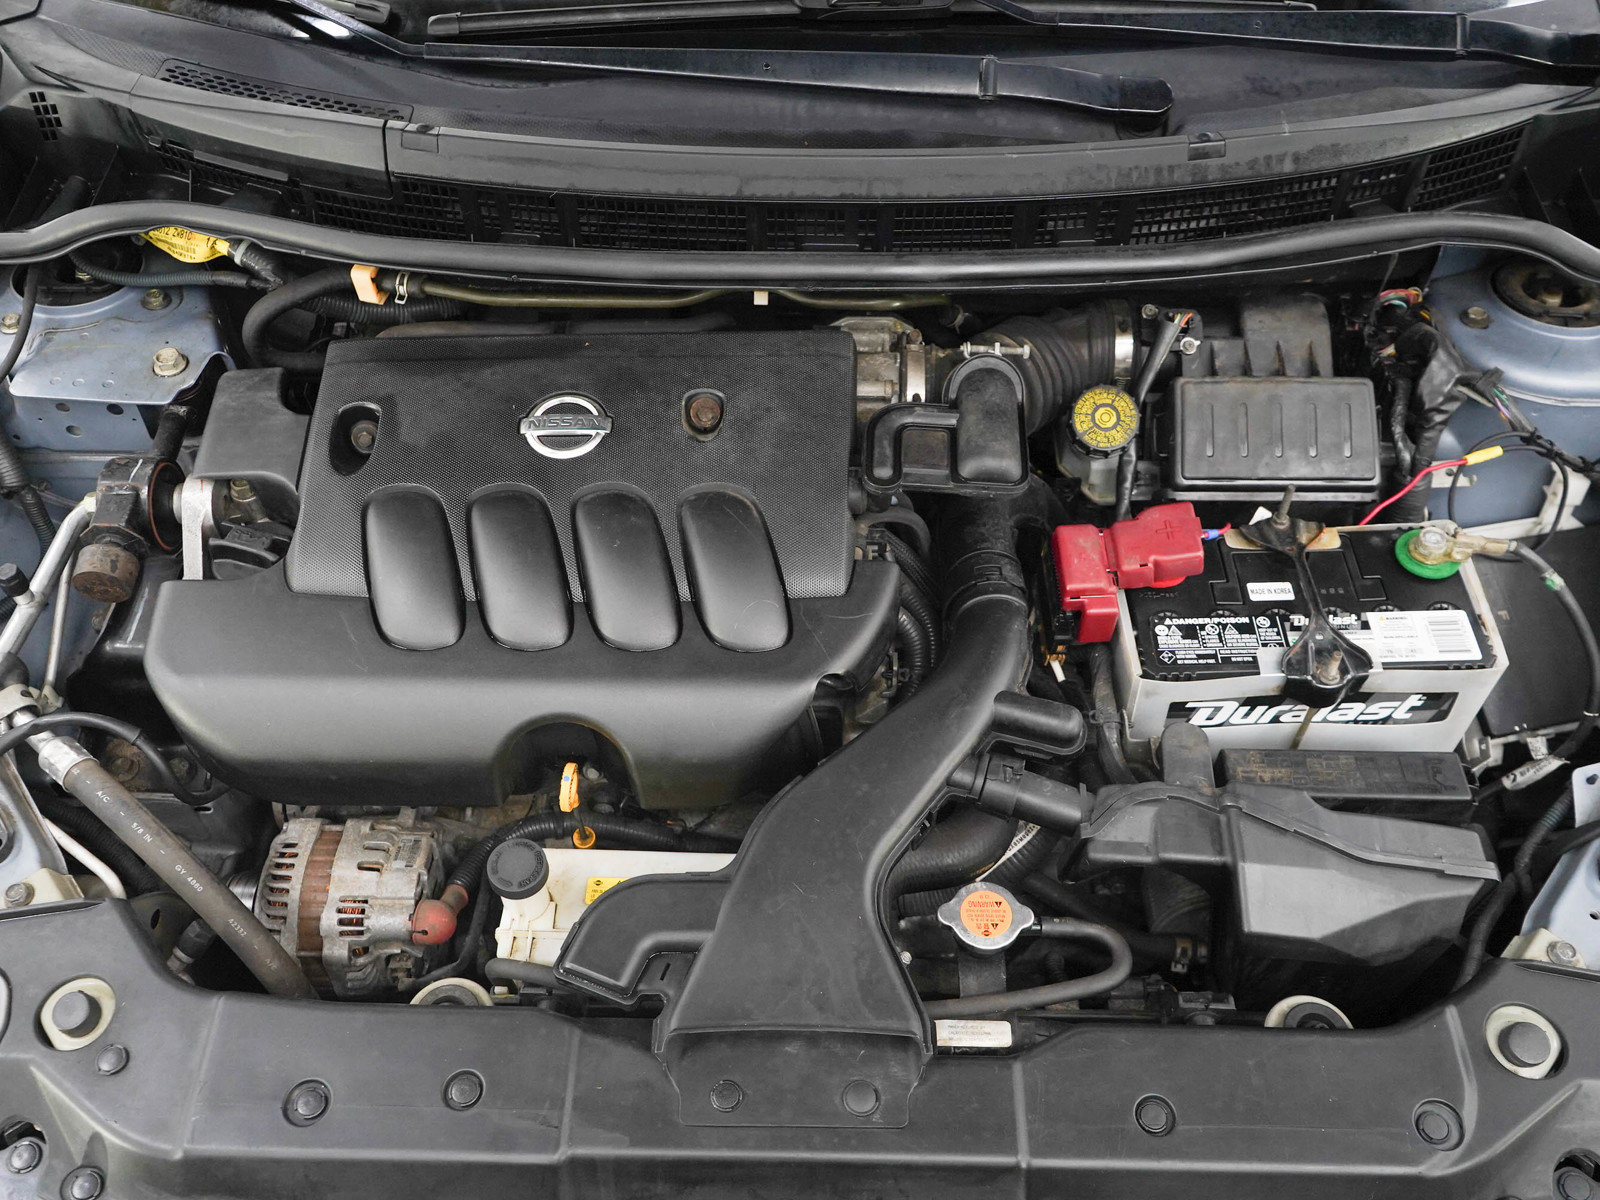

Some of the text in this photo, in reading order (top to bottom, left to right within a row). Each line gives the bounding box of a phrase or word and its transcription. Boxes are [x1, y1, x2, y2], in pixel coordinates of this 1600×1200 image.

[527, 416, 606, 429] NISSAN
[1172, 617, 1249, 625] DANGER/POISON
[1289, 613, 1358, 627] Dlast
[1185, 694, 1424, 727] Duralast
[96, 790, 110, 803] A/C
[143, 833, 153, 843] IN
[174, 864, 187, 876] GY
[968, 900, 995, 908] WARNING
